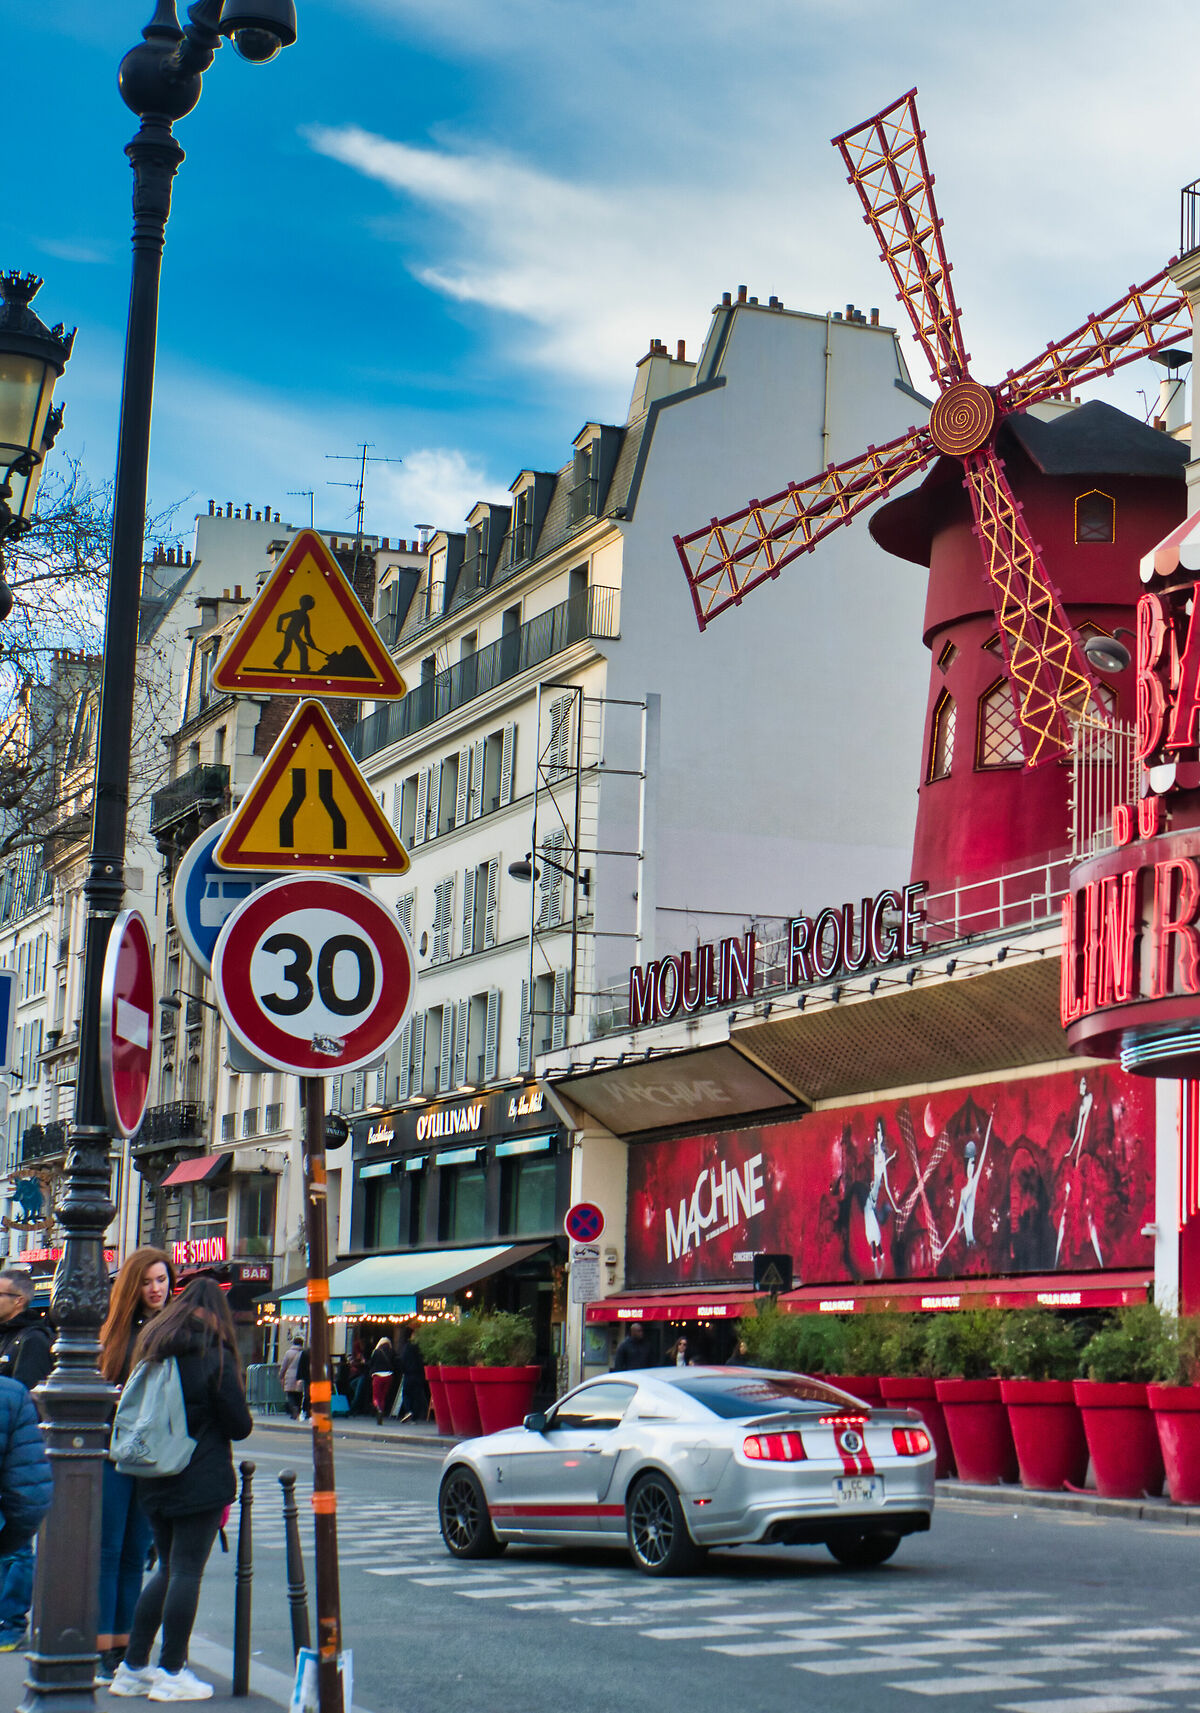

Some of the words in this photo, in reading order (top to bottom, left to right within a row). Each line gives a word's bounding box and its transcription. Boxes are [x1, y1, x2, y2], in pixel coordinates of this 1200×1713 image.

[1113, 796, 1159, 846] DU
[260, 933, 375, 1016] 30
[629, 931, 756, 1027] MOULIN
[789, 880, 929, 985] ROUGE
[416, 1104, 482, 1140] O'SULLIVANS
[665, 1153, 765, 1264] MACHINE
[172, 1240, 187, 1264] THE
[190, 1237, 224, 1264] STATION
[242, 1268, 268, 1279] BAR
